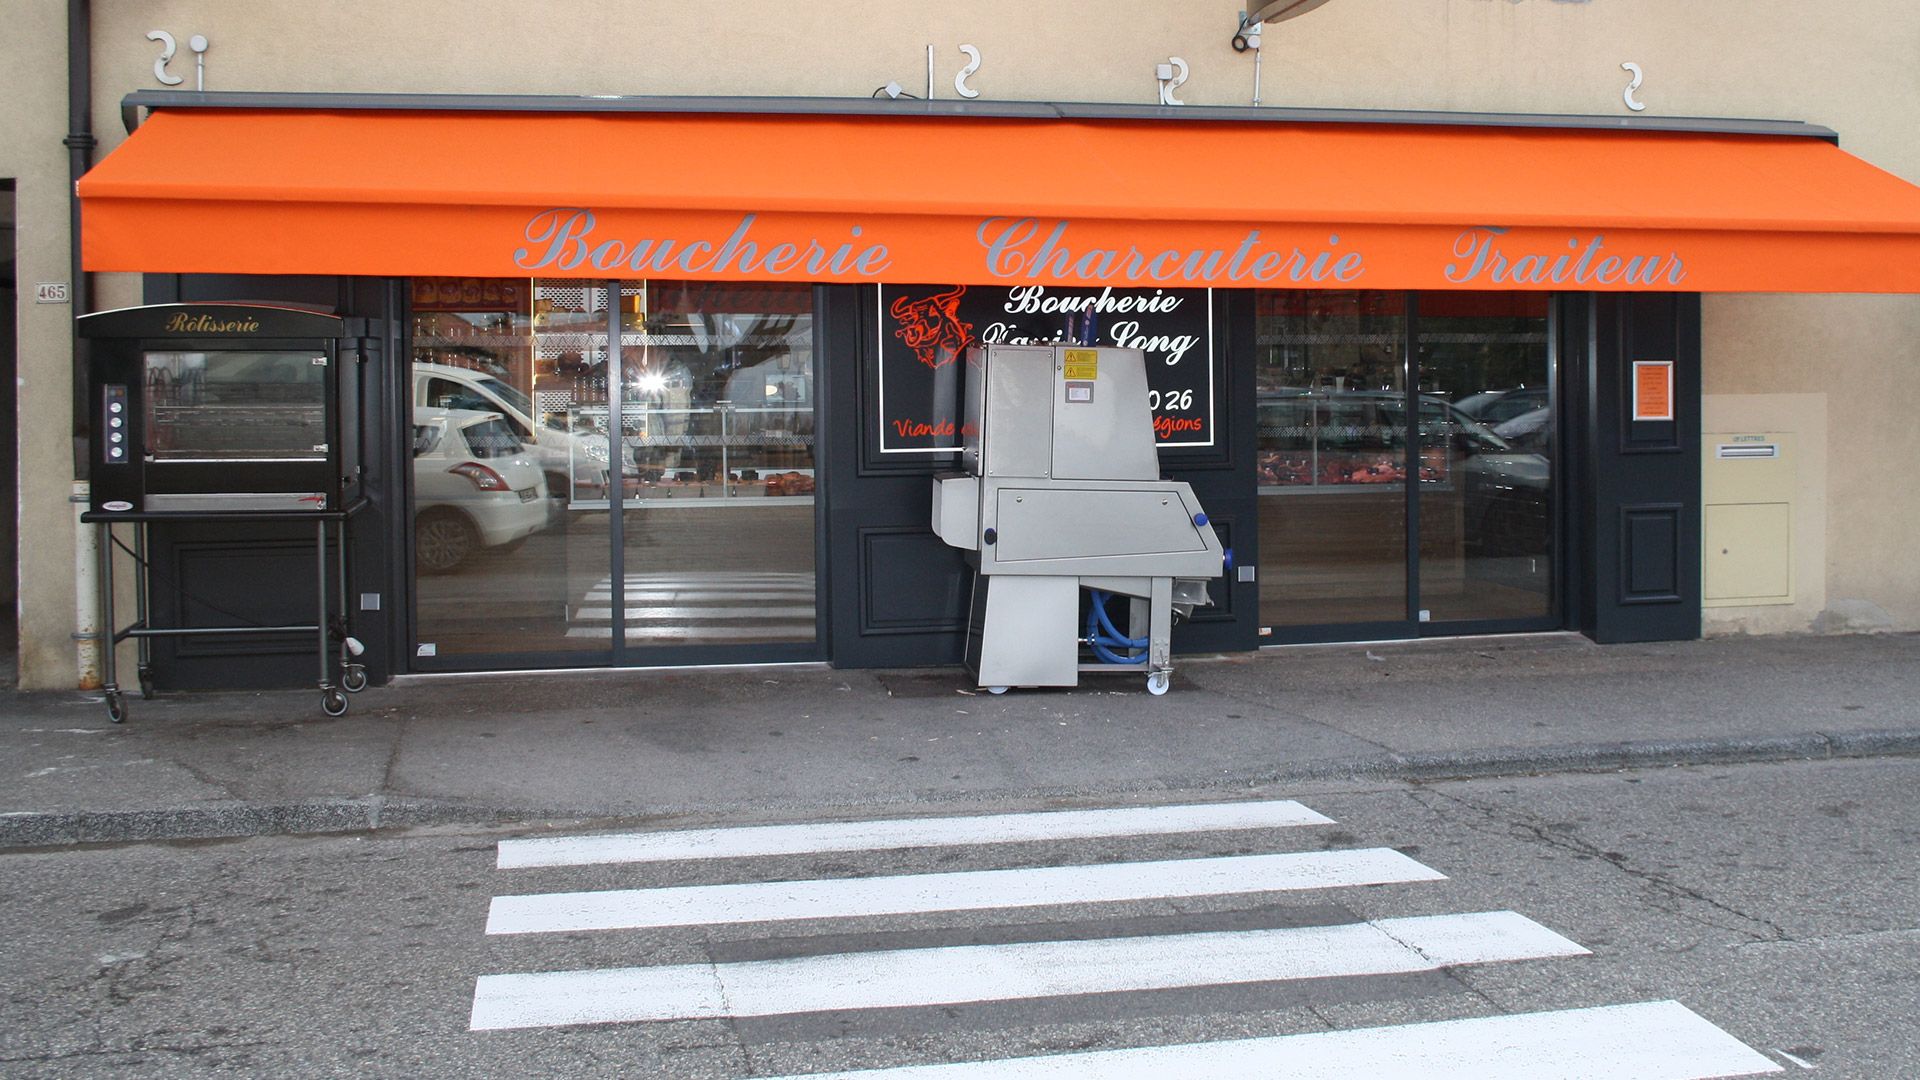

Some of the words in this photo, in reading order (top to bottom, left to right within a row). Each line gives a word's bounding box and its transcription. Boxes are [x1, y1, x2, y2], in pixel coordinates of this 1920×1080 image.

[513, 207, 893, 276] Boucherie
[976, 216, 1366, 282] Charcuterie
[1443, 226, 1687, 285] Traiteur
[39, 285, 65, 299] 465
[1004, 286, 1183, 315] Boucherie
[166, 312, 259, 332] Rôtisserie
[1110, 321, 1199, 366] Long
[1165, 389, 1193, 410] 26
[892, 417, 955, 437] Viande
[1153, 416, 1201, 439] égions
